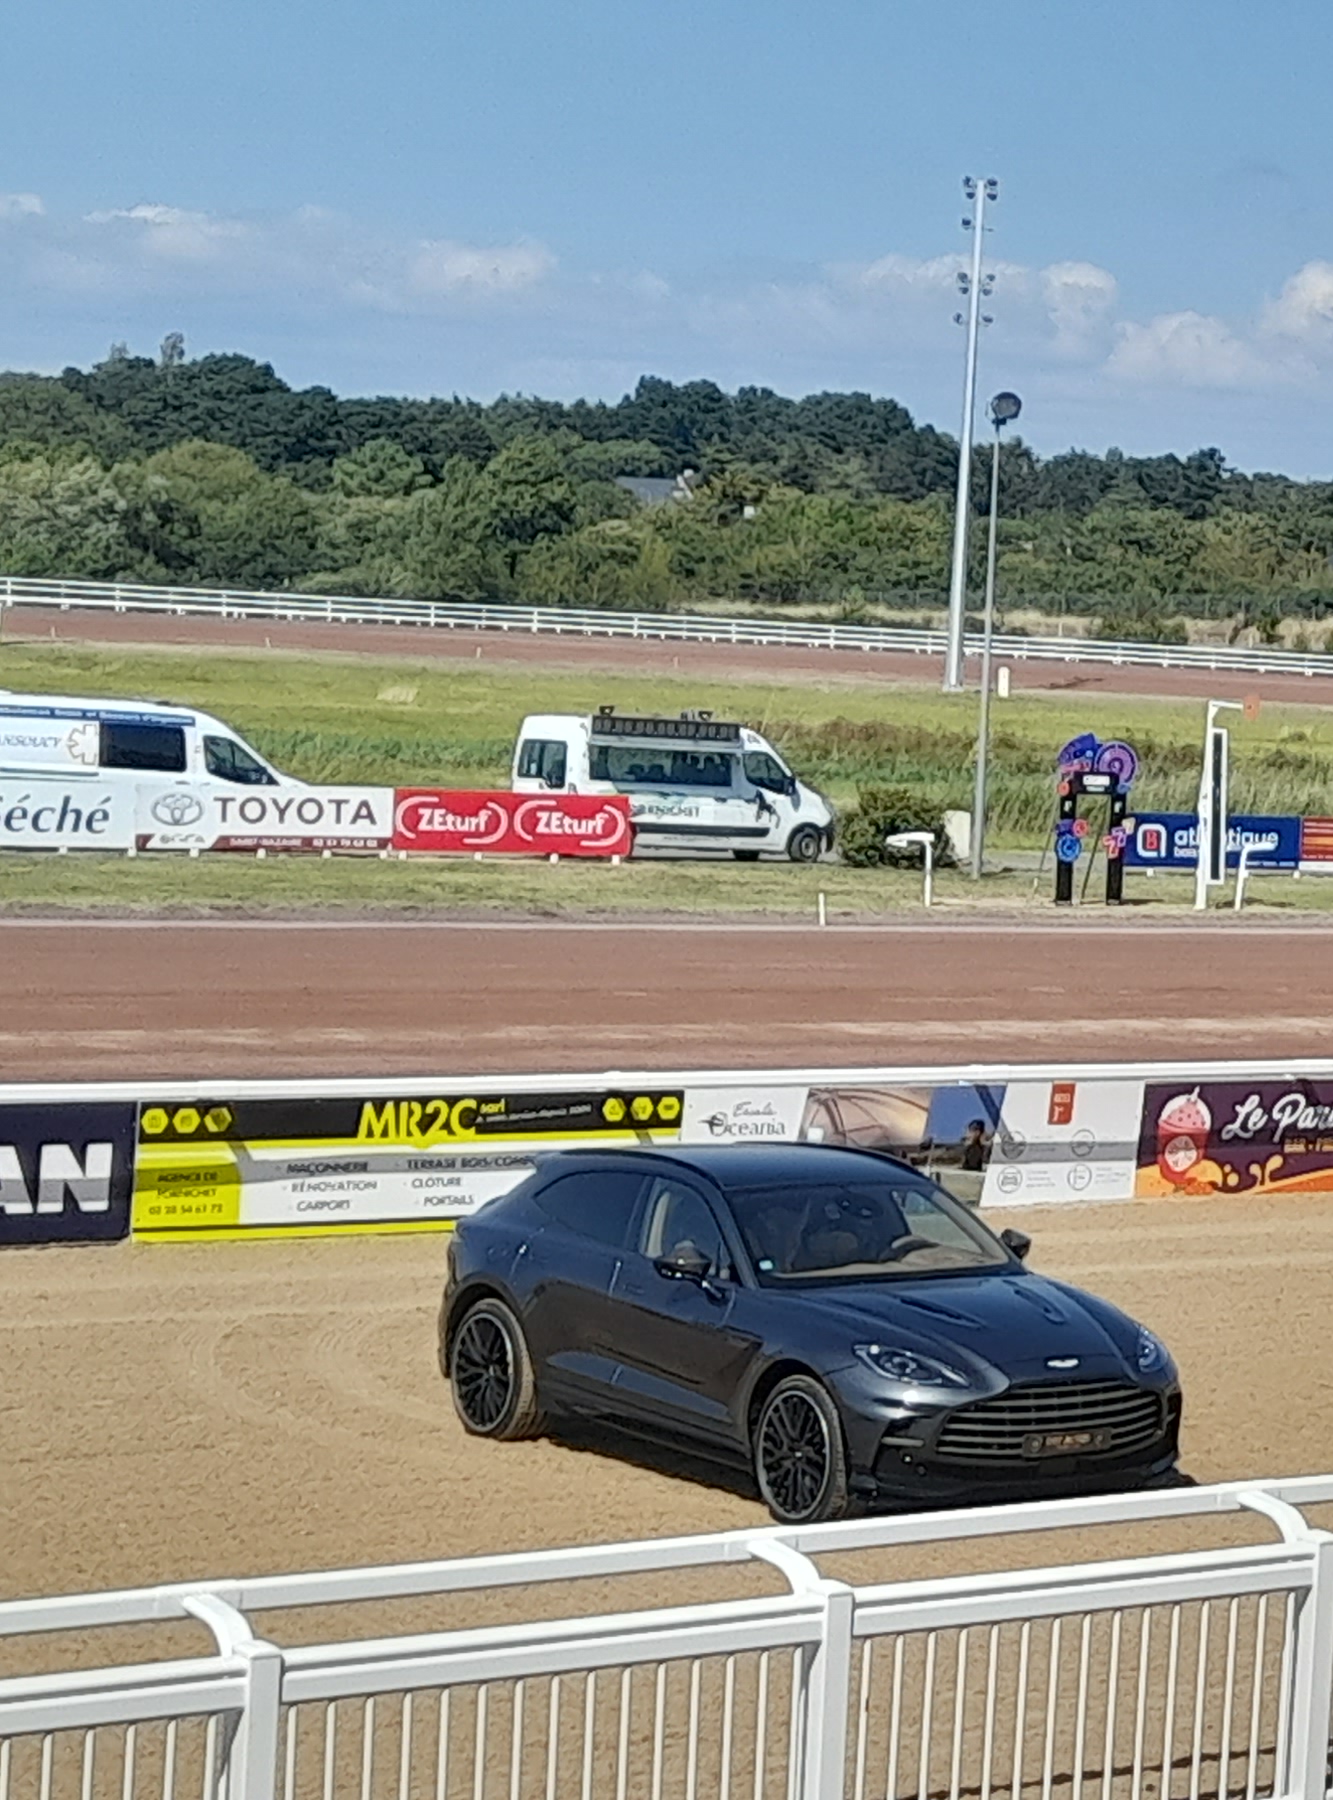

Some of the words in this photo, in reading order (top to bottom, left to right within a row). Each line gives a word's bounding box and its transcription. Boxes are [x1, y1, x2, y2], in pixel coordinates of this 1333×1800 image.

[0, 793, 112, 834] éché
[213, 796, 378, 826] TOYOTA
[417, 807, 492, 833] ZEturf
[535, 810, 610, 835] ZEturf
[356, 1098, 478, 1139] MR2C
[1221, 1094, 1268, 1141] Le
[296, 1199, 351, 1213] CARPORT
